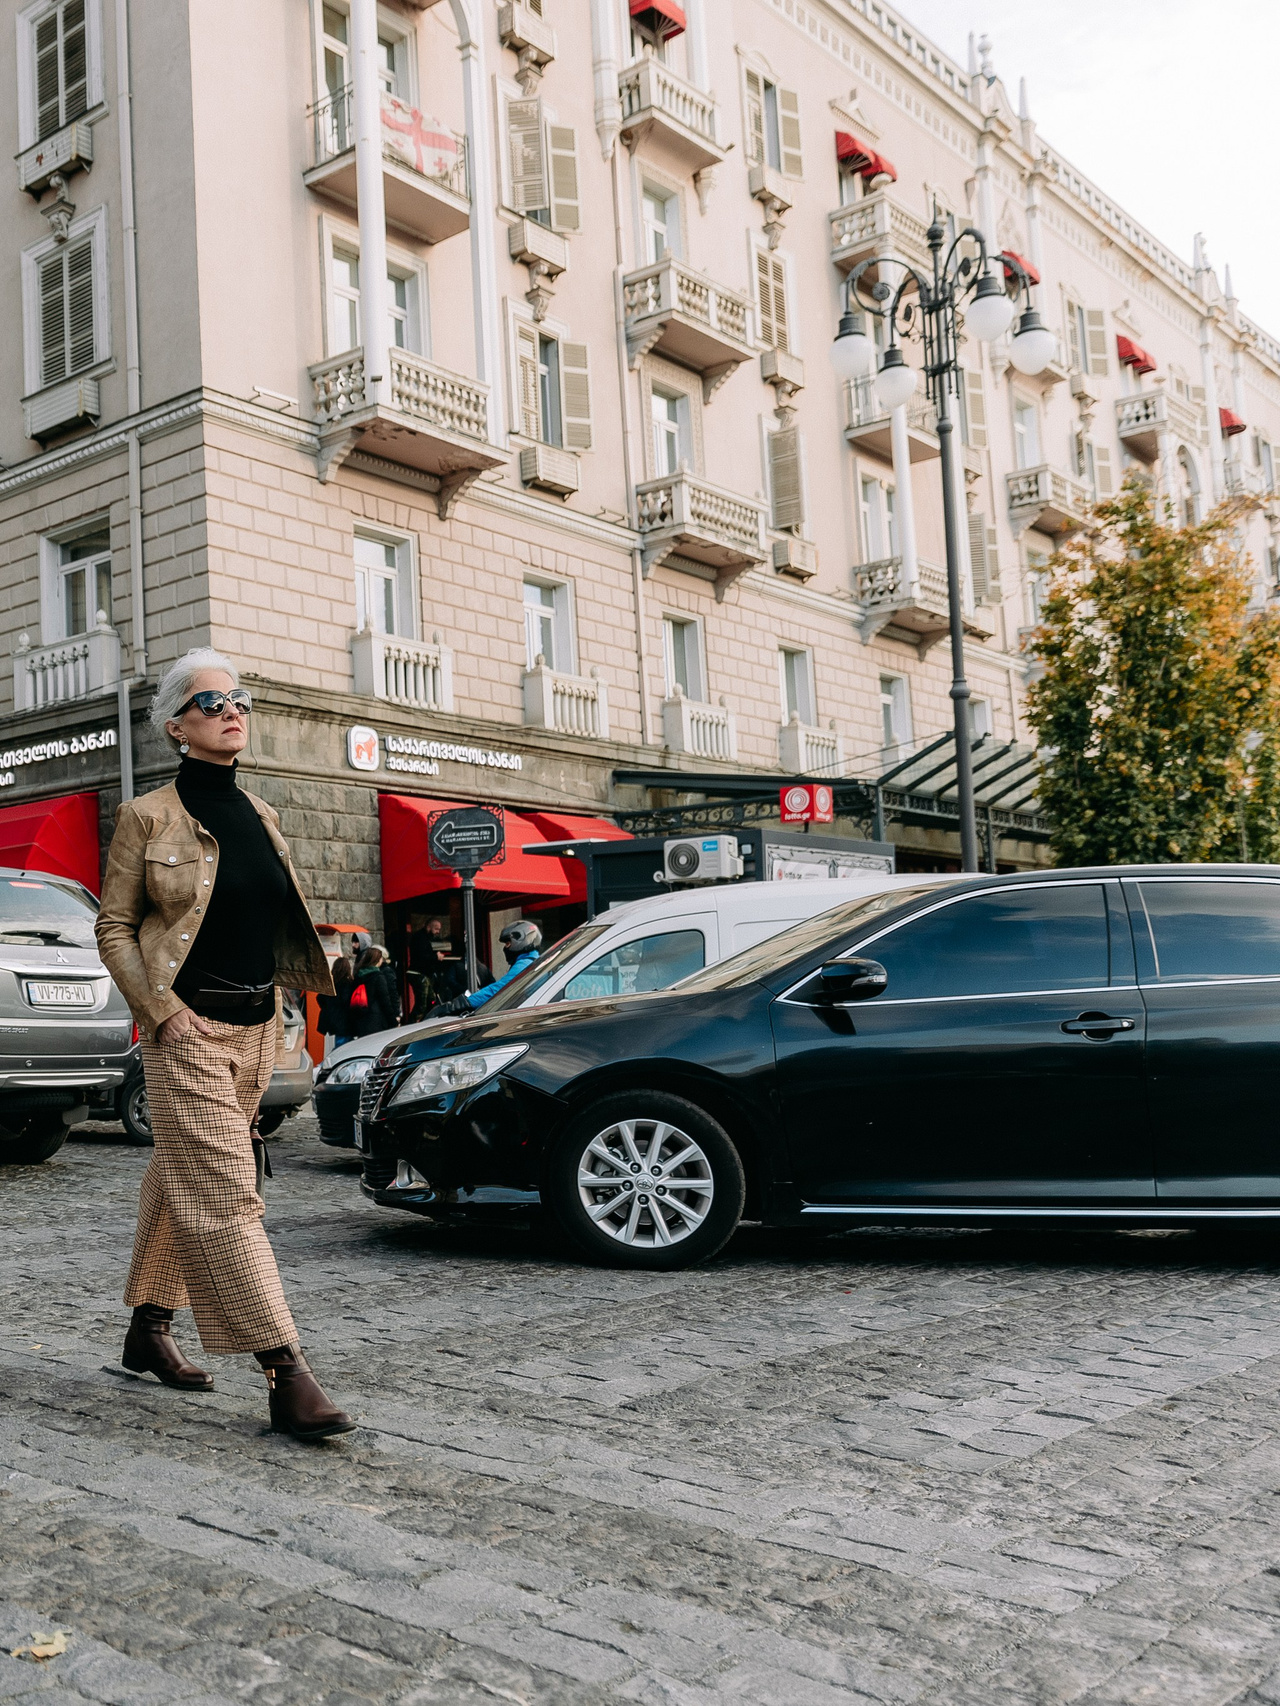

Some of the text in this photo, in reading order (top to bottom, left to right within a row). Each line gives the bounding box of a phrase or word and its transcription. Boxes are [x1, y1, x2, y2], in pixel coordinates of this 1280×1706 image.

[70, 729, 118, 754] ბანკი
[385, 735, 523, 770] საქართველოს ბანკი
